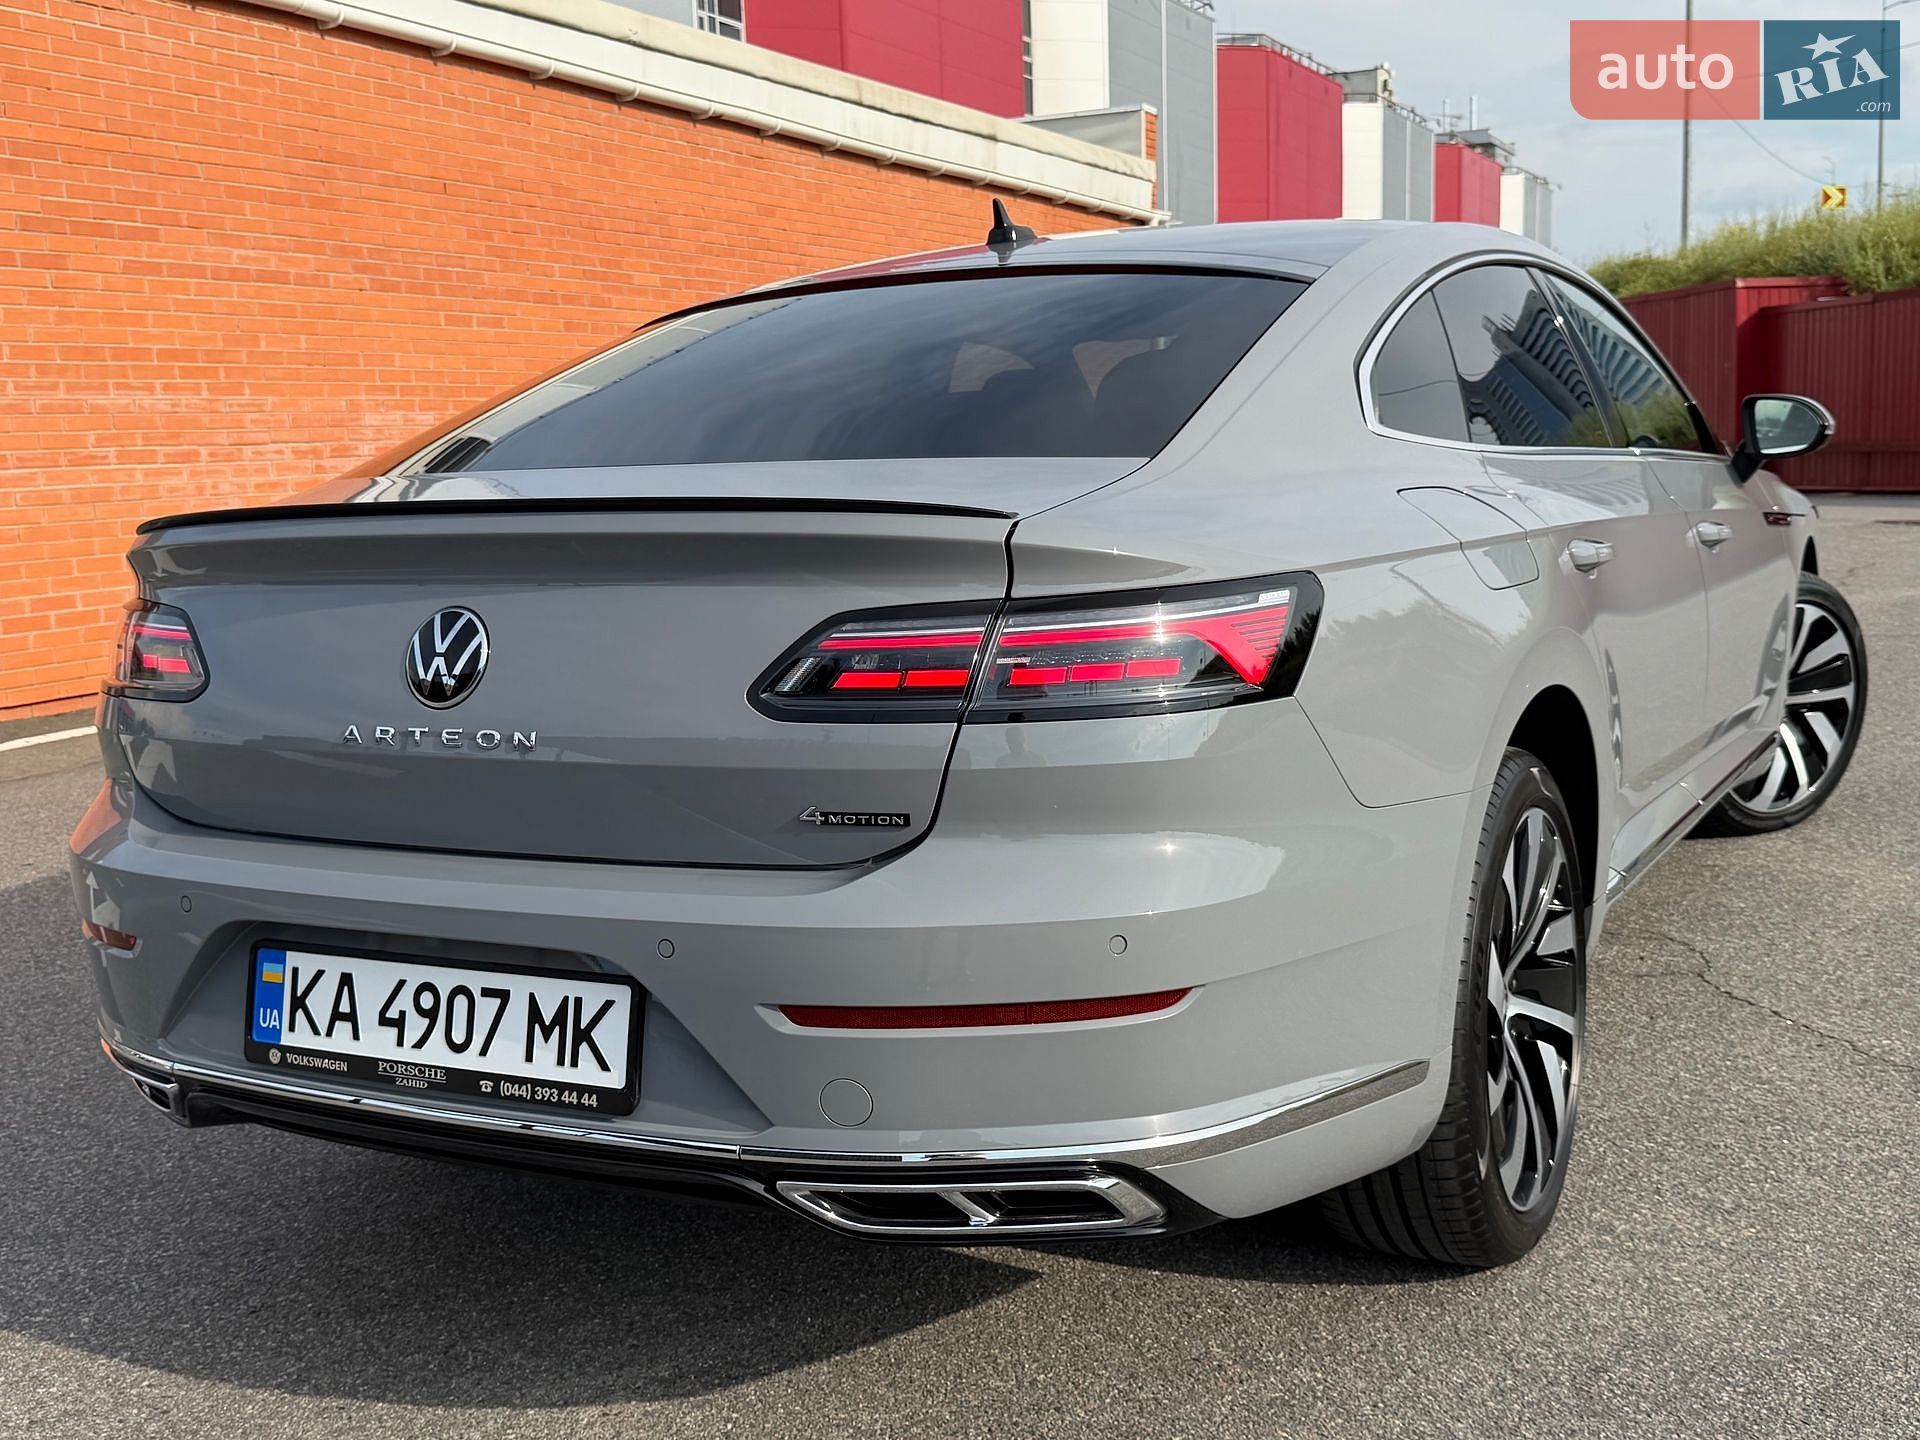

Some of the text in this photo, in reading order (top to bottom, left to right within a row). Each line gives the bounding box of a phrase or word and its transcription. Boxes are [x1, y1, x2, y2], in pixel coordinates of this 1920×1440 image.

[343, 724, 537, 751] ARTEON
[259, 1008, 280, 1030] UA
[288, 966, 616, 1072] KA 4907 MK
[286, 1052, 348, 1072] VOLKSWAGEN
[377, 1061, 447, 1081] PORSCHE
[395, 1077, 428, 1089] ZAHID
[500, 1080, 599, 1108] (044) 393 44 44
